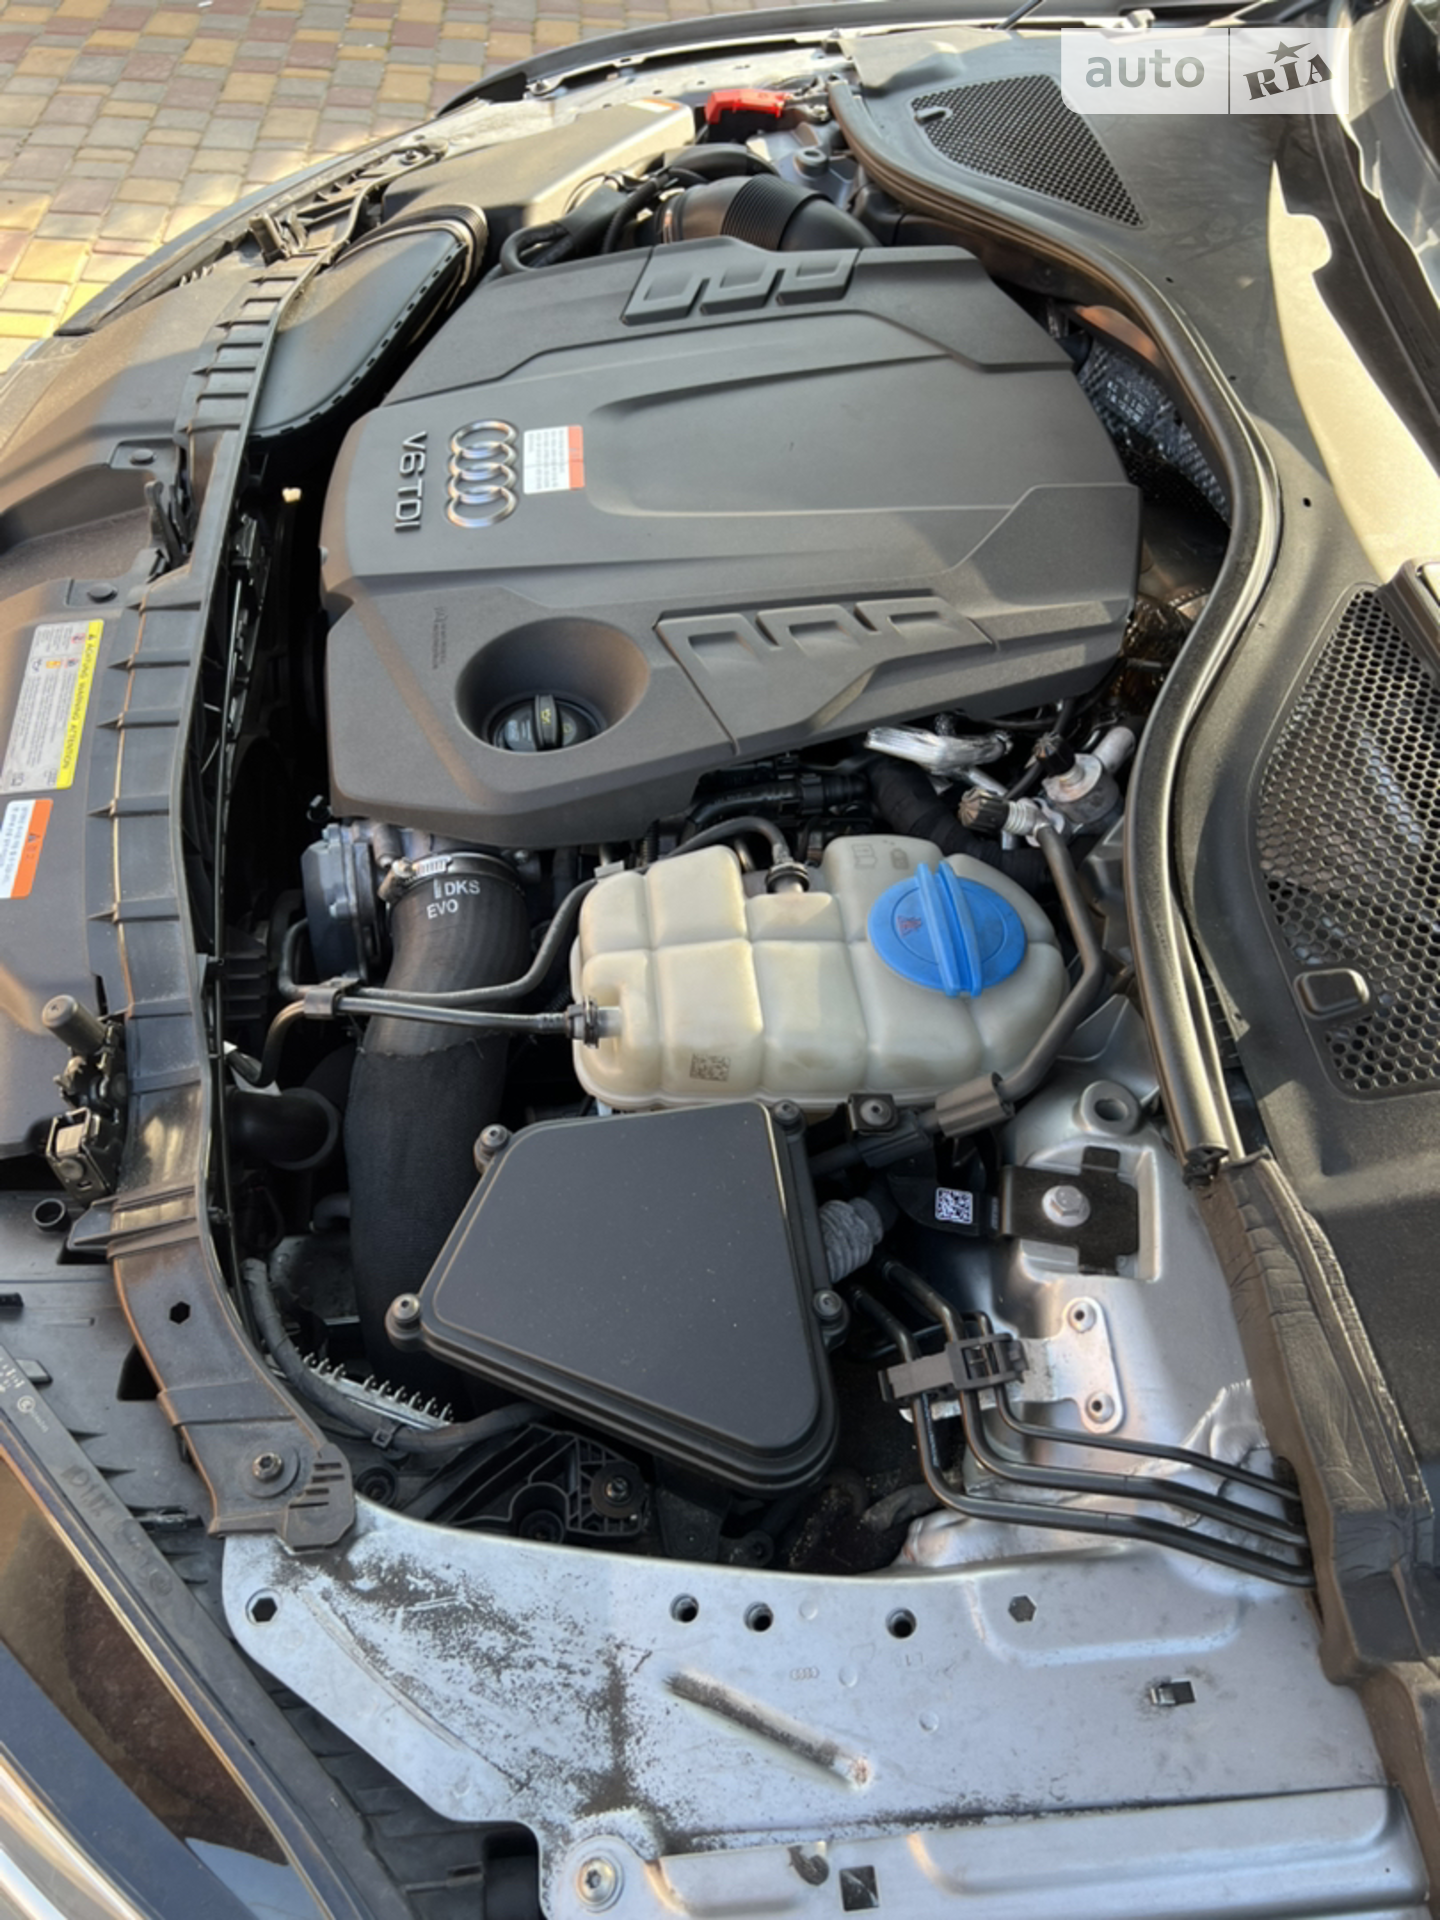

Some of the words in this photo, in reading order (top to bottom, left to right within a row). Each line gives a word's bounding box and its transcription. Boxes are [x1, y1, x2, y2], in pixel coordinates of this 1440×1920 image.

[400, 431, 427, 475] V6
[395, 479, 423, 531] TDI
[72, 682, 86, 720] WARNING
[63, 724, 77, 769] ATTENTION
[444, 880, 480, 896] DKS
[427, 899, 458, 919] EVO
